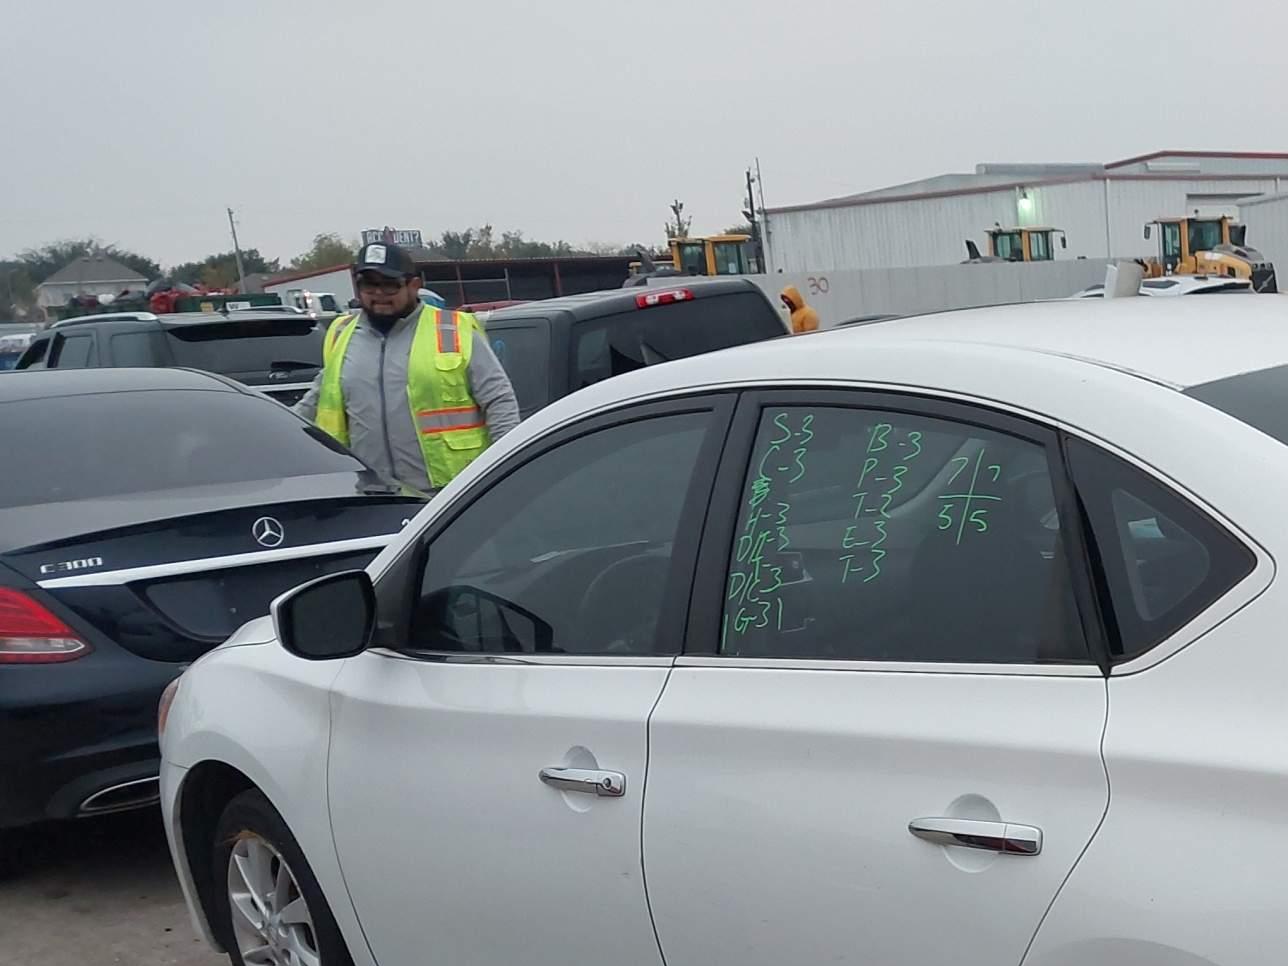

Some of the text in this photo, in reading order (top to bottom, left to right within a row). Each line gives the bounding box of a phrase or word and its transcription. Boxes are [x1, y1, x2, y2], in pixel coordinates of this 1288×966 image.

[807, 276, 829, 296] 30
[866, 423, 922, 461] B-3
[857, 458, 908, 494] P-3
